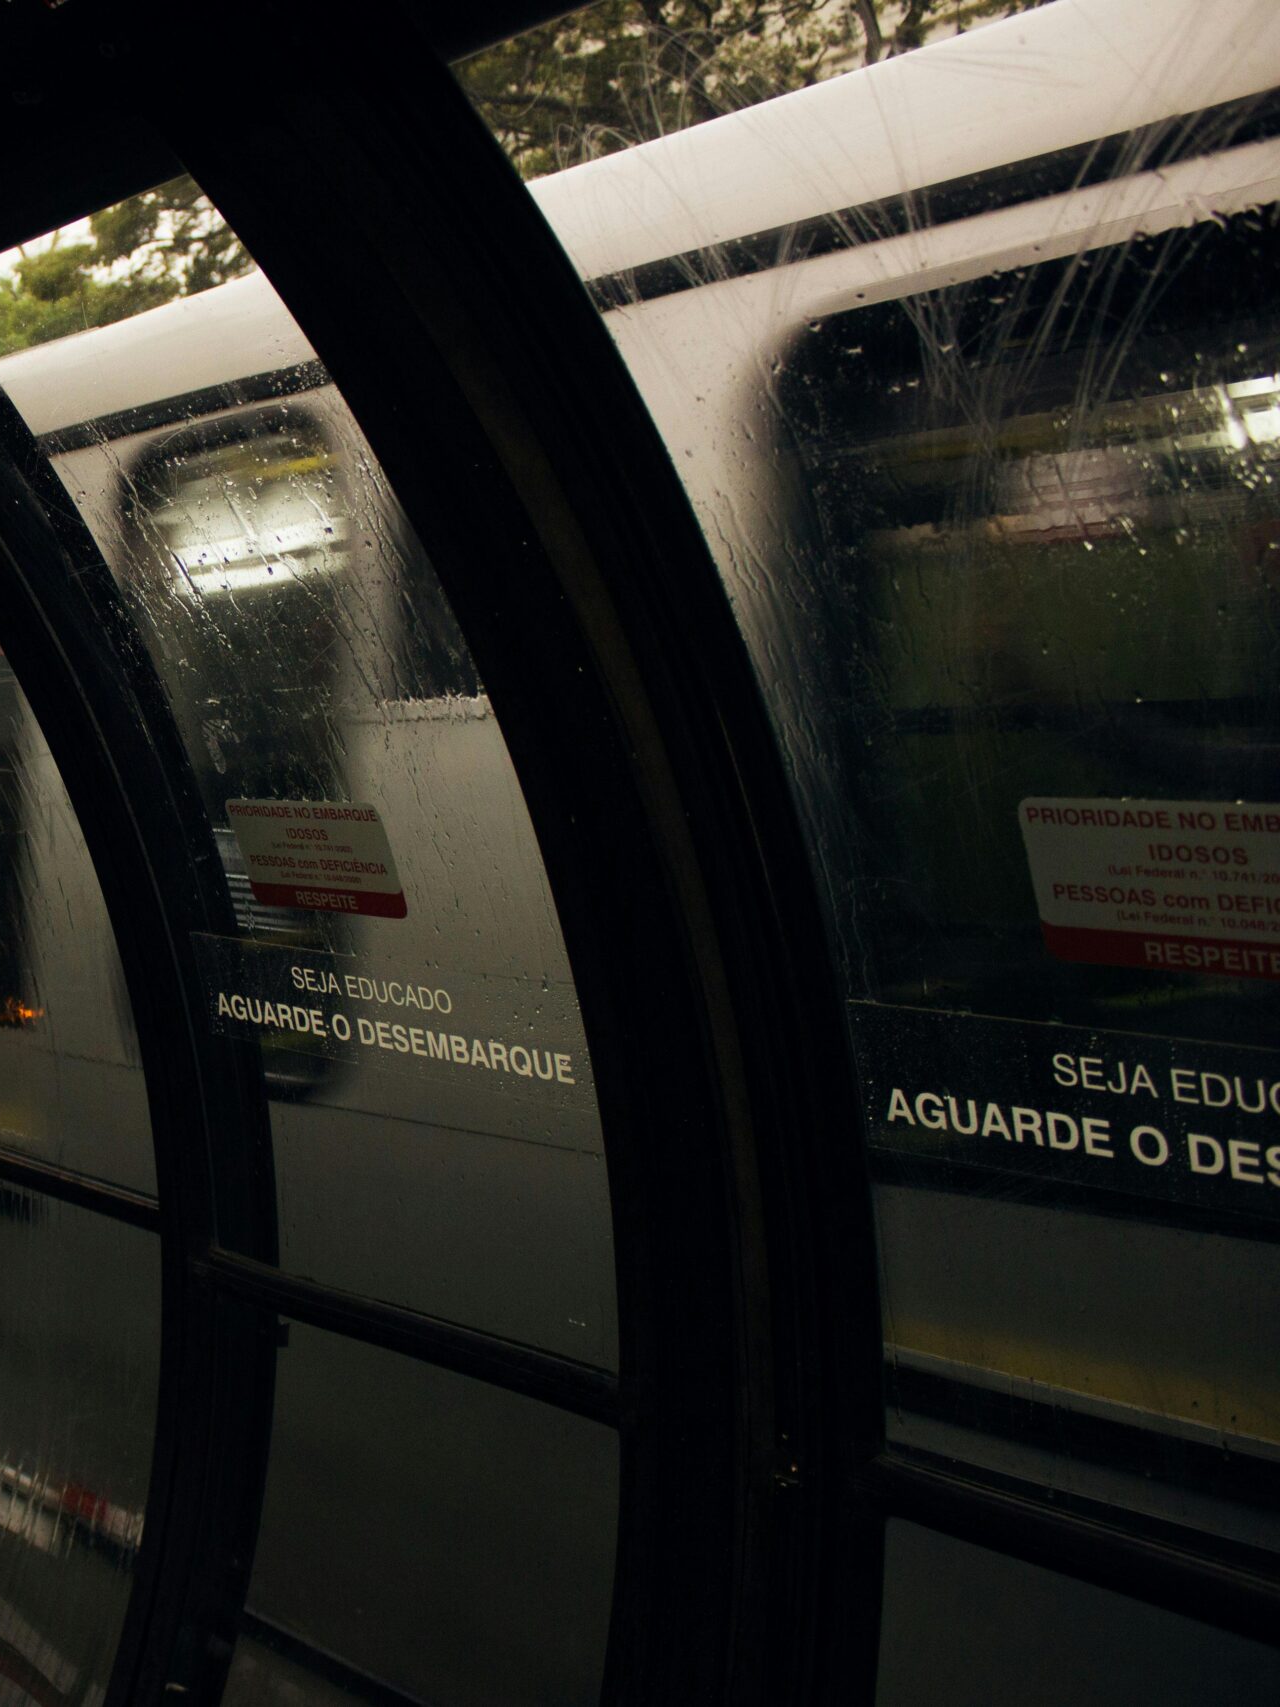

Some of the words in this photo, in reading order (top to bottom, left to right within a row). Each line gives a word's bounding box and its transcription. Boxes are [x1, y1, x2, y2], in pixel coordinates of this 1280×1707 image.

[228, 804, 292, 818] PRIORIDADE
[293, 806, 311, 820] NO
[314, 807, 378, 823] EMBARQUE
[1025, 807, 1171, 830] PRIORIDADE
[1178, 811, 1217, 831] NO
[1224, 812, 1280, 834] EMB
[285, 827, 329, 841] IDOSOS
[249, 854, 296, 869] PESSOAS
[297, 860, 318, 870] com
[319, 858, 388, 876] DEFICIÊNCIA
[1147, 843, 1249, 866] IDOSOS
[1135, 865, 1185, 880] Federal
[295, 890, 359, 911] RESPEITE
[1052, 883, 1156, 907] PESSOAS
[1163, 894, 1210, 910] com
[1144, 911, 1194, 926] Federal
[1143, 940, 1280, 975] RESPEITE
[291, 966, 342, 997] SEJA
[345, 975, 453, 1015] EDUCADO
[218, 992, 327, 1037] AGUARDE
[332, 1013, 352, 1042] O
[357, 1017, 576, 1085] DESEMBARQUE
[1052, 1052, 1160, 1099] SEJA
[886, 1087, 1116, 1159] AGUARDE
[1129, 1125, 1170, 1167] O
